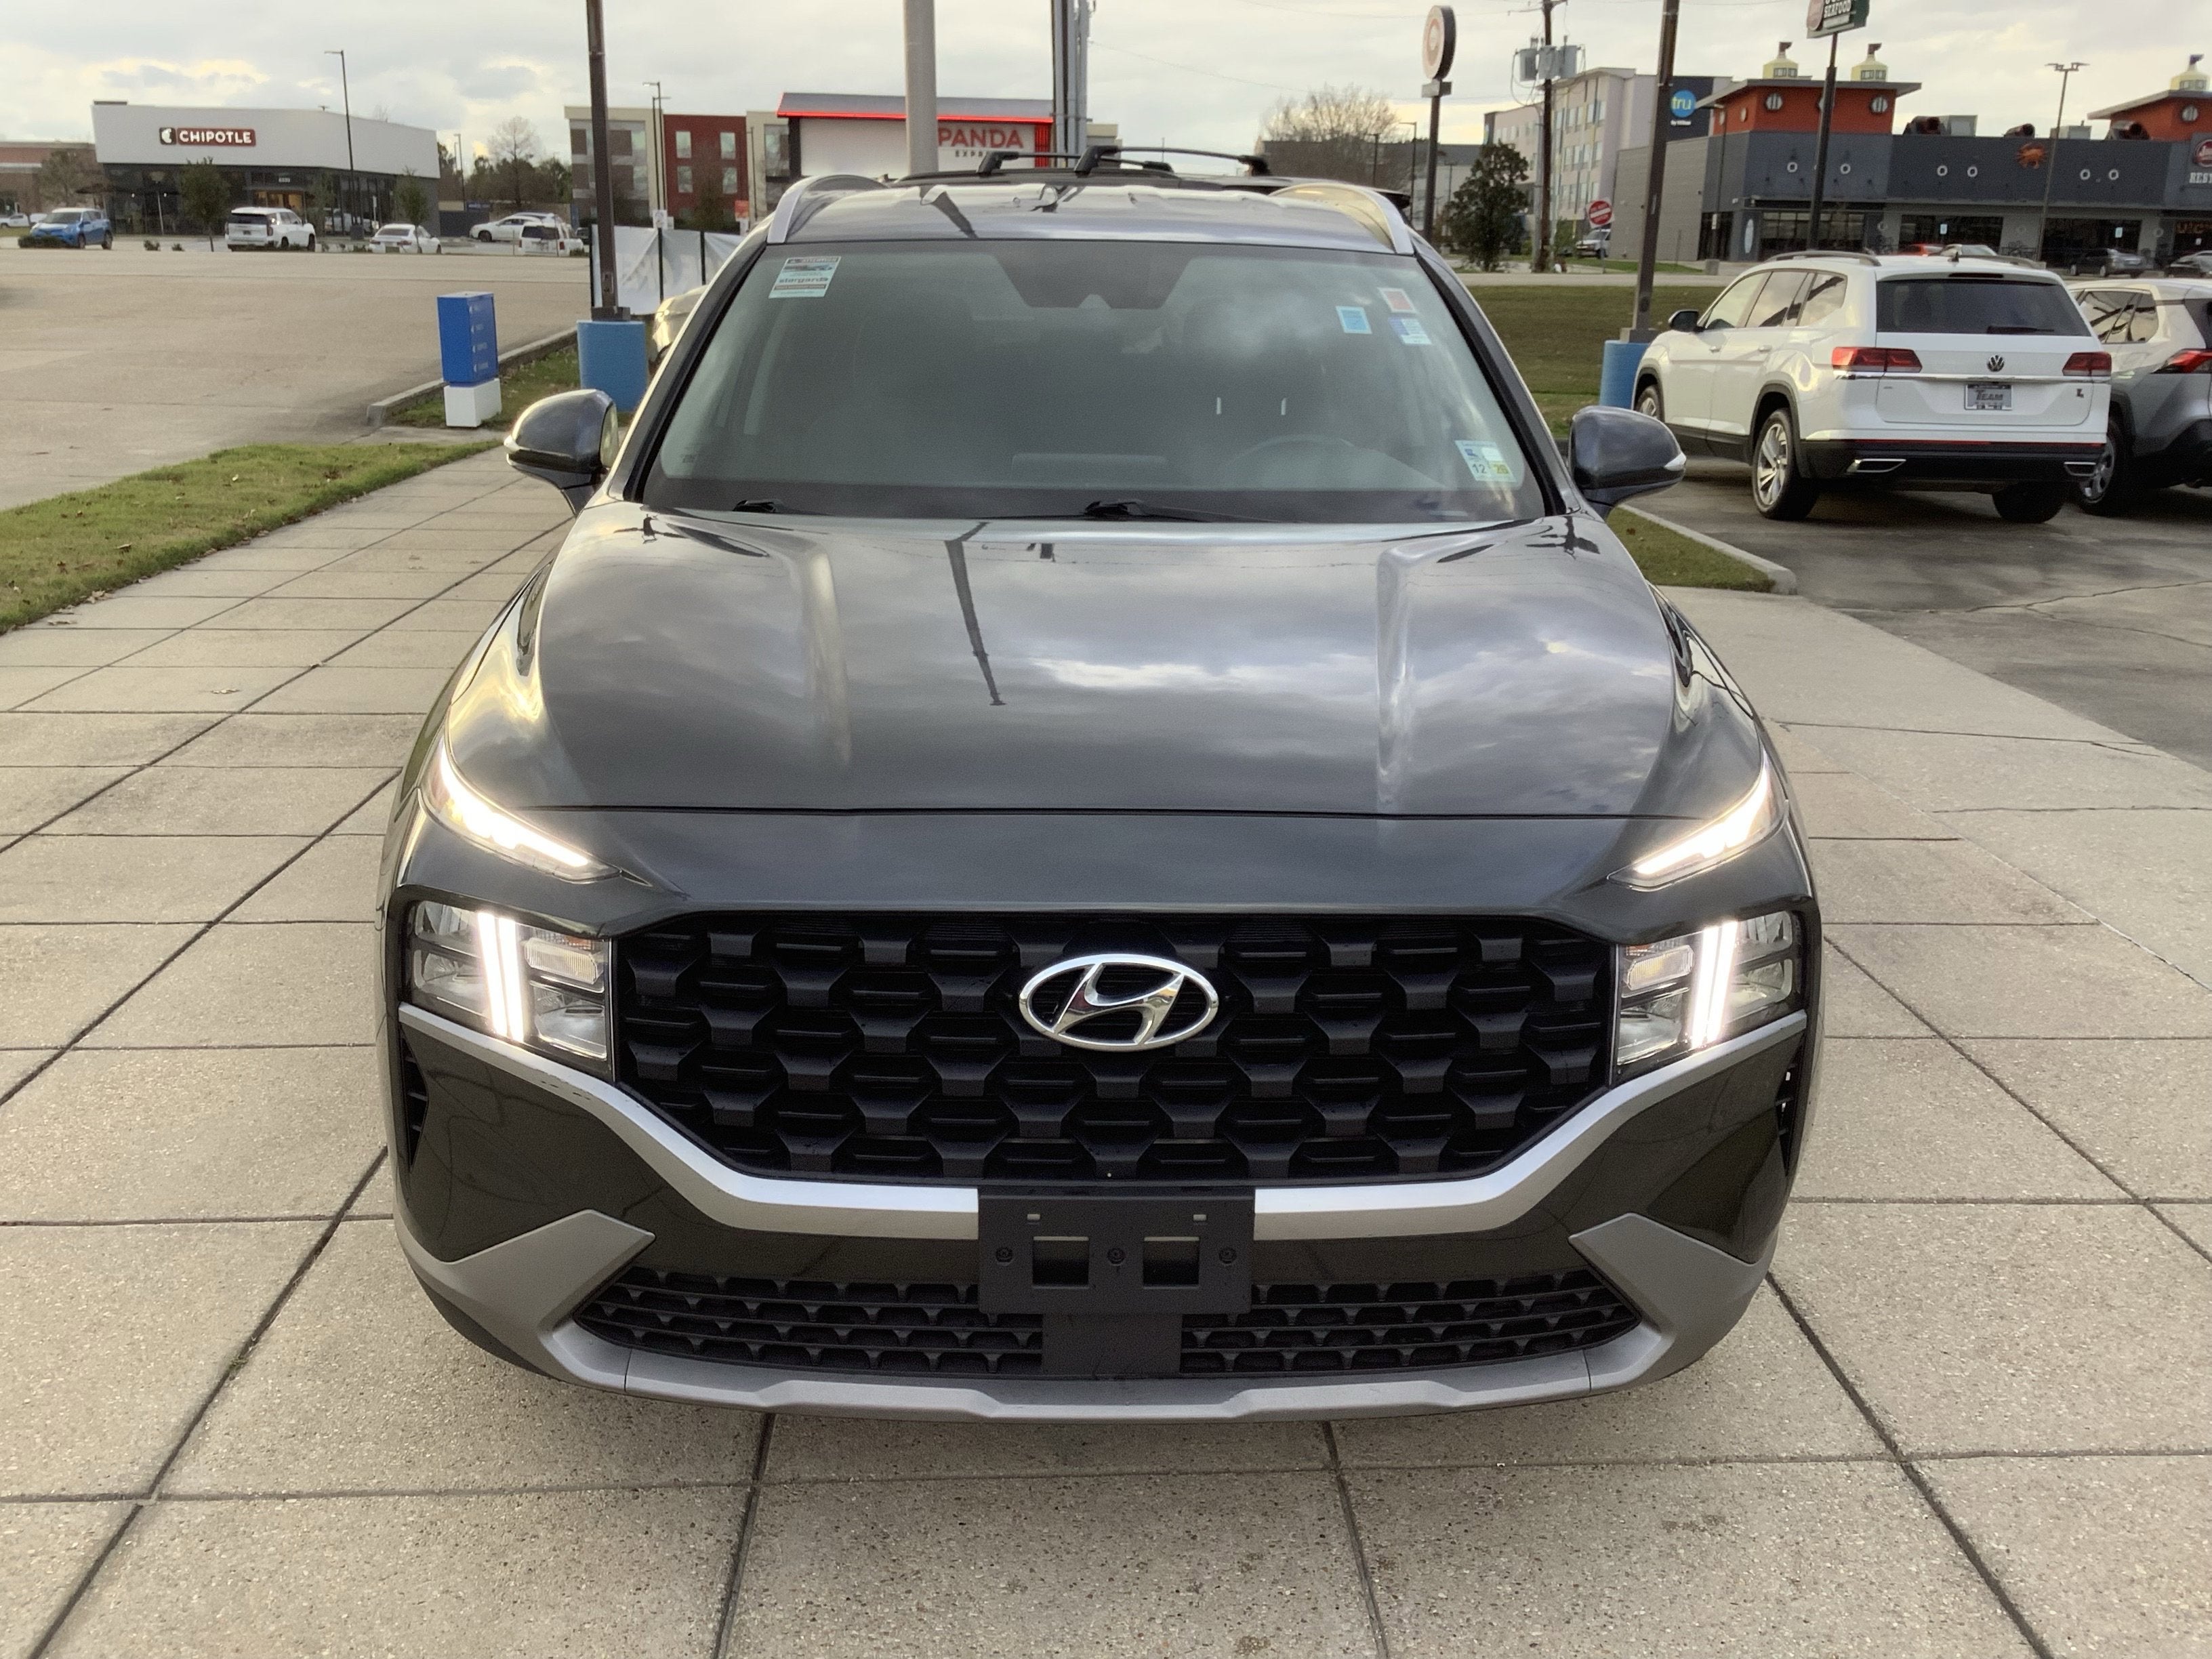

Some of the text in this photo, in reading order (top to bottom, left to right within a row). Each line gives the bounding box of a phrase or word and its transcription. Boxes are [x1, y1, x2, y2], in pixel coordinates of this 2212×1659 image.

[1824, 0, 1851, 18] SEAFOOD
[1671, 96, 1692, 110] tru
[179, 129, 252, 144] CHIPOTLE
[938, 127, 1024, 148] PANDA
[1472, 464, 1488, 474] 12
